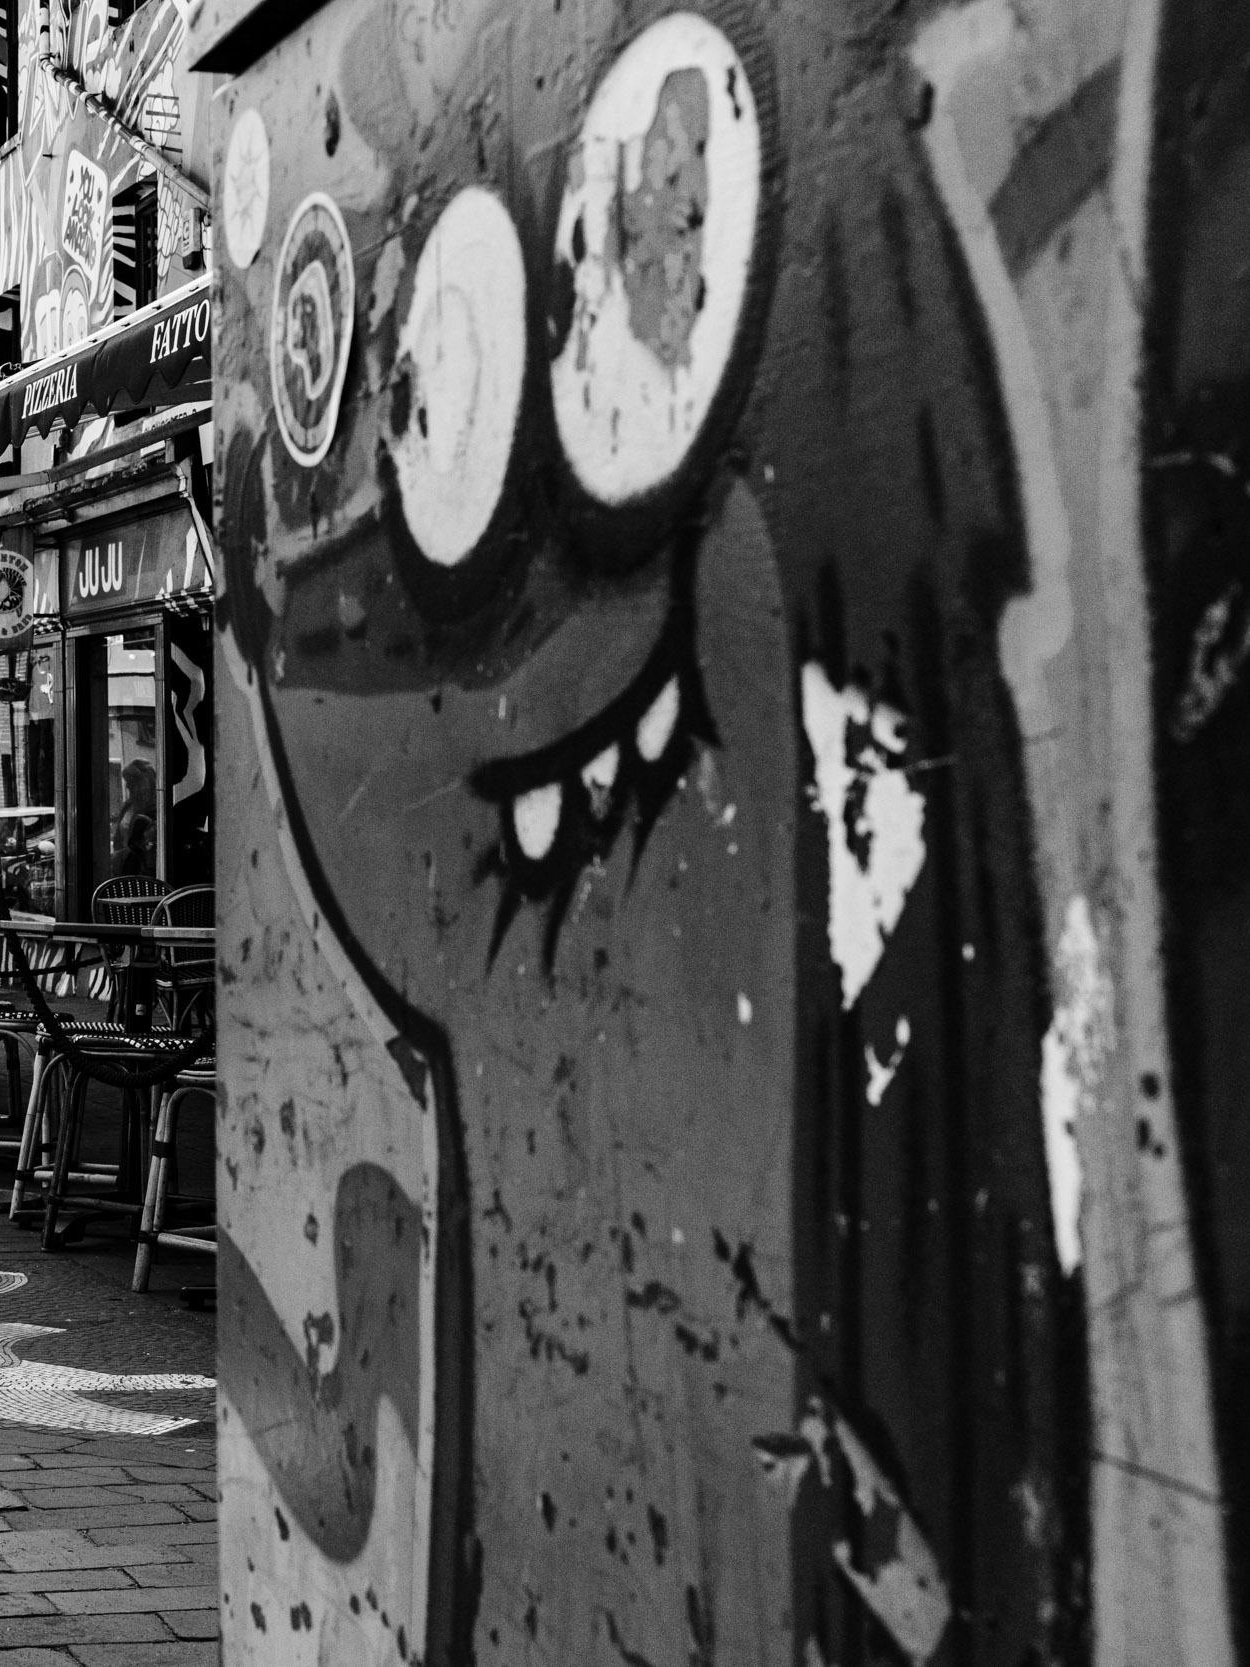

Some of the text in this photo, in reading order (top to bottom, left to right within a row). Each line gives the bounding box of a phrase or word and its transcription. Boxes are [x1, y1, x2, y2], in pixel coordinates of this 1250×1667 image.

[79, 165, 95, 204] YOU
[150, 299, 210, 363] FATTO
[21, 362, 78, 419] PIZZERIA
[79, 541, 123, 598] JUJU
